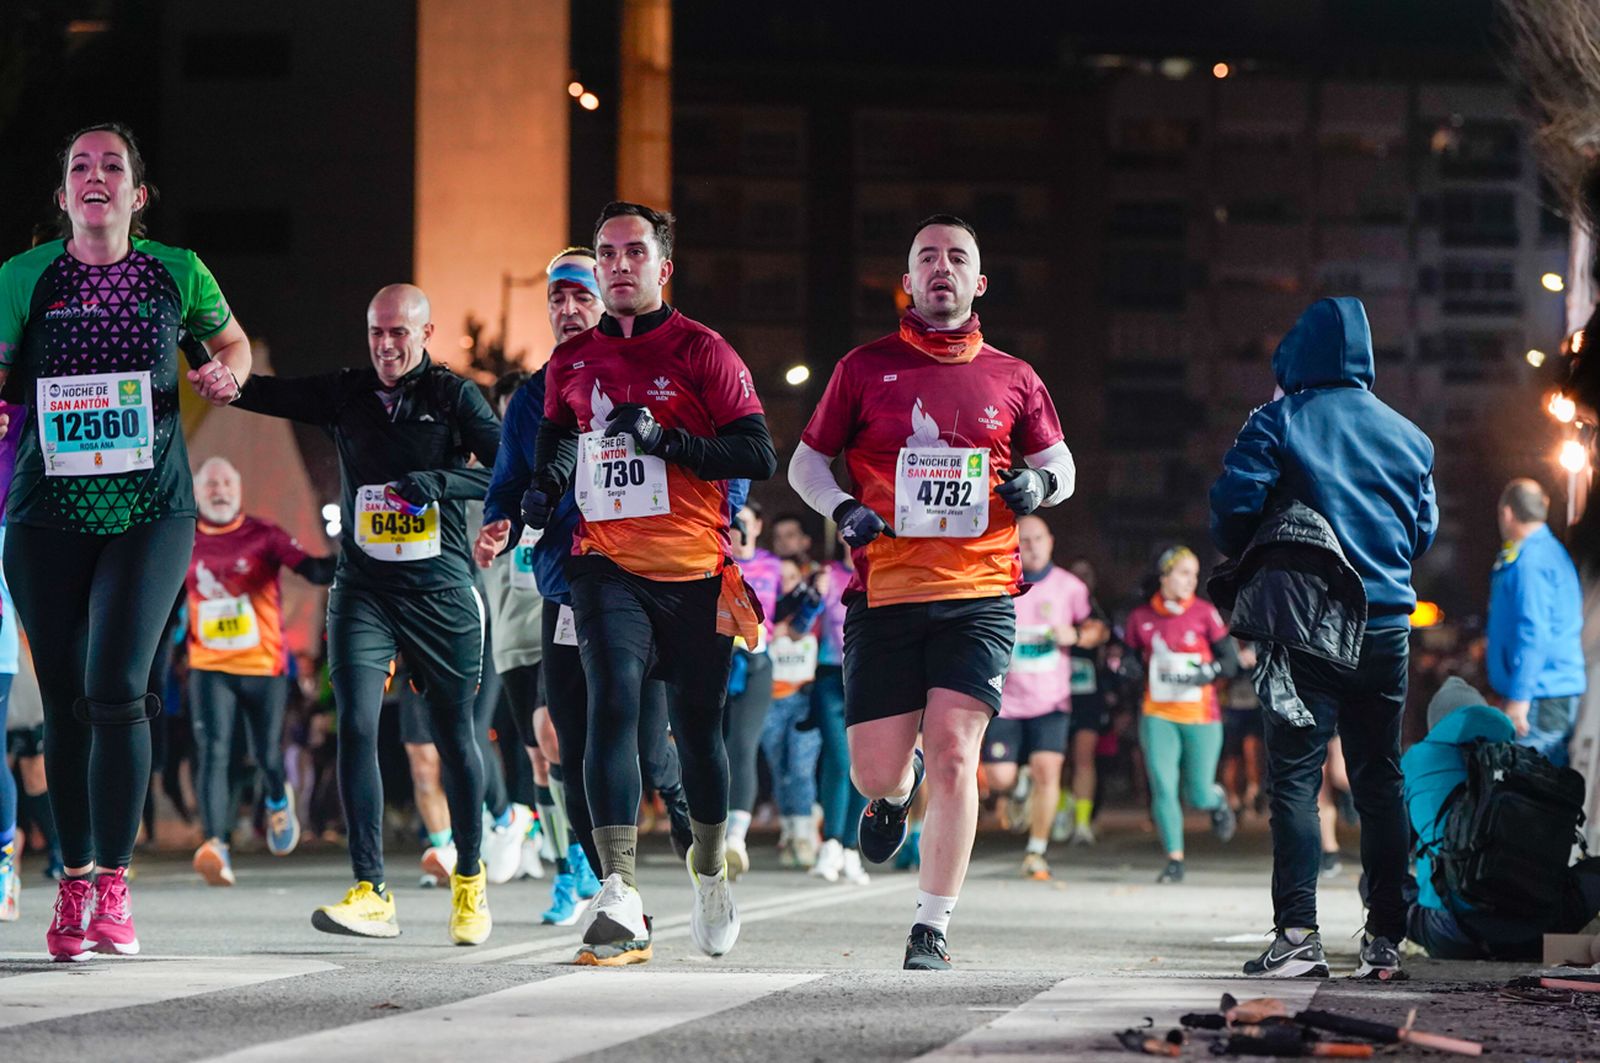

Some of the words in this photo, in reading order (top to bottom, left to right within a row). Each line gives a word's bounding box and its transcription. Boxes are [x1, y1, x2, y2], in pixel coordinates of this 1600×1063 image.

[62, 387, 94, 397] NOCHE
[95, 386, 108, 396] DE
[50, 400, 71, 411] SAN
[73, 396, 109, 410] ANTÓN
[52, 408, 140, 443] 12560
[80, 442, 98, 450] ROSA
[100, 441, 115, 449] ANA
[616, 438, 626, 447] DE
[919, 458, 949, 467] NOCHE
[950, 458, 962, 467] DE
[593, 459, 645, 489] 4730
[907, 468, 927, 478] SAN
[929, 466, 962, 479] ANTÓN
[917, 480, 972, 507] 4732
[365, 503, 381, 511] SAN
[371, 512, 425, 535] 6435
